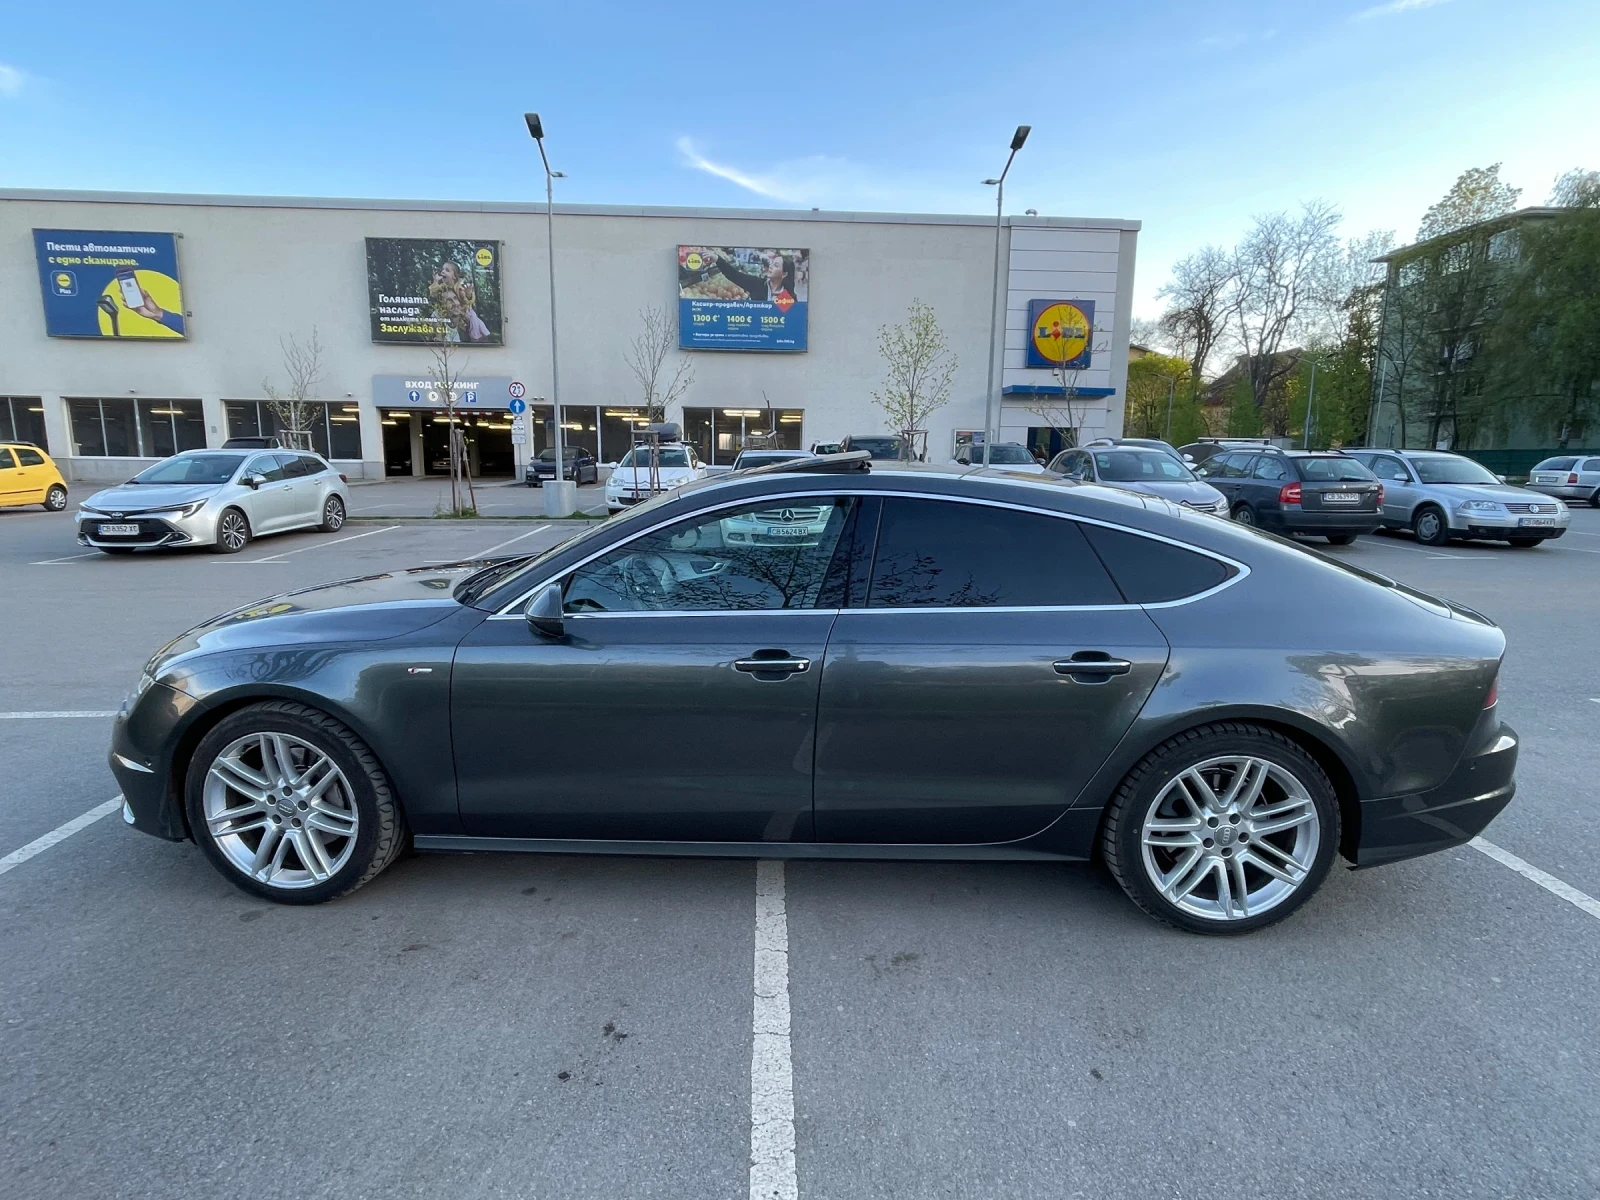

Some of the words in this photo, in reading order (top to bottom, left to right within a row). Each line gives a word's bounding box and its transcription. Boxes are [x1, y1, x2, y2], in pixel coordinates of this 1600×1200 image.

[46, 241, 81, 252] Пести
[83, 242, 156, 254] автоматично
[48, 256, 55, 264] с
[56, 256, 81, 266] едно
[83, 255, 139, 267] сканиране.
[378, 293, 429, 304] Голямата
[379, 306, 420, 316] наслада
[693, 314, 711, 322] 1300
[726, 315, 745, 323] 1400
[746, 315, 752, 323] €
[760, 316, 779, 324] 1500
[779, 316, 785, 324] €
[380, 323, 434, 335] Заслужава
[405, 380, 432, 389] ВХОД
